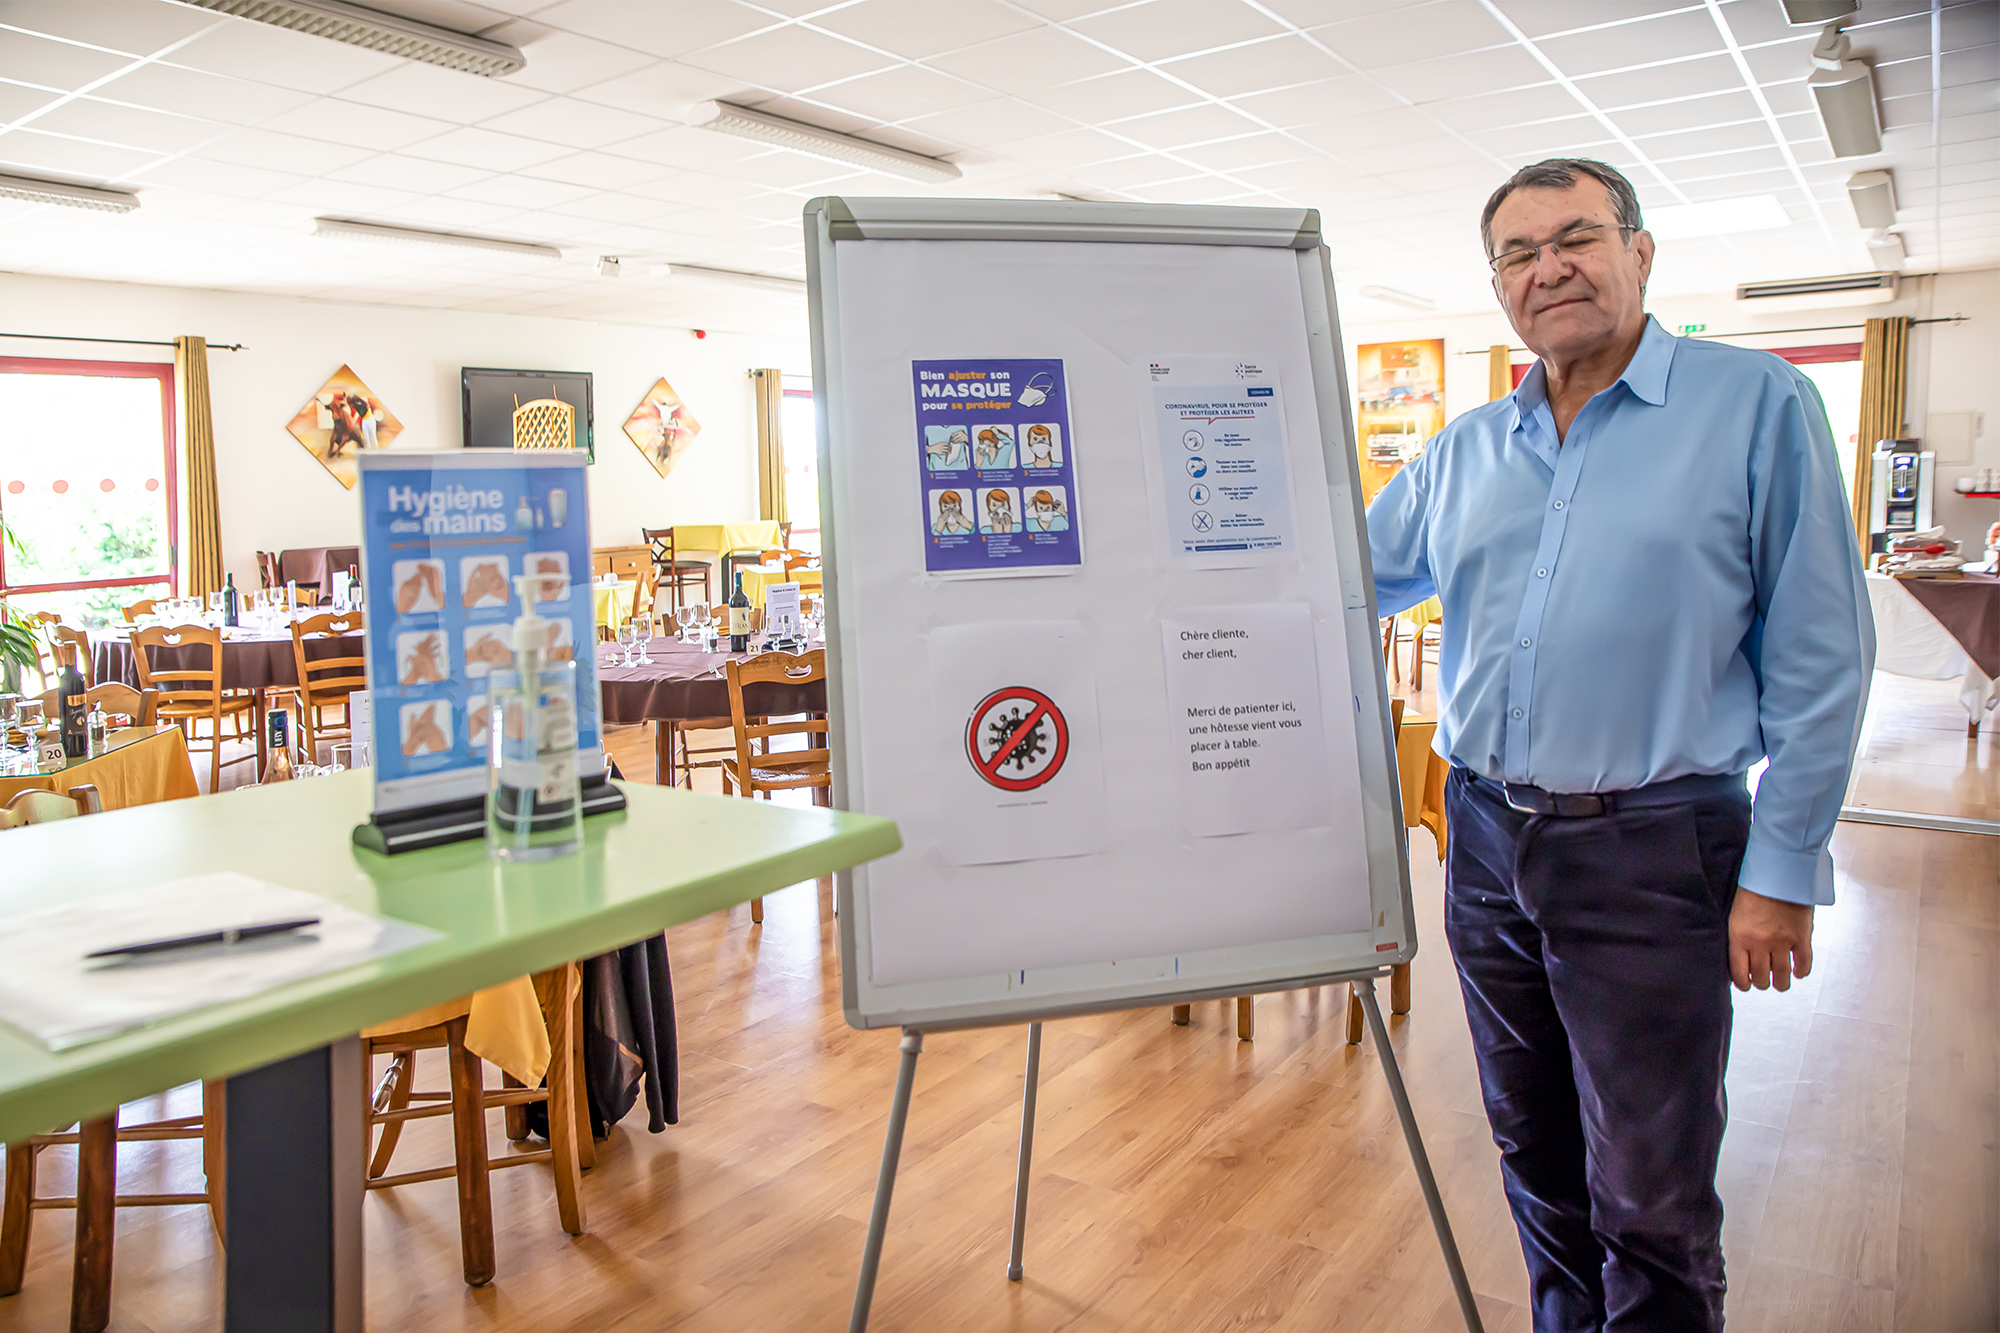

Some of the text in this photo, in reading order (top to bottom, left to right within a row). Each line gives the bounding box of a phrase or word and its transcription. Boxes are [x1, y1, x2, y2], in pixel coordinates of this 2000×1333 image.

[920, 371, 1010, 381] Bien ajuster son
[921, 383, 1011, 399] MASQUE
[922, 400, 1011, 412] pour se protéger
[388, 484, 504, 518] Hygiène
[390, 510, 507, 535] des mains
[1180, 629, 1249, 641] Chère cliente,
[1182, 649, 1237, 660] cher client,
[1187, 701, 1296, 717] Merci de patienter ici,
[1189, 719, 1302, 734] une hôtesse vient vous
[1190, 738, 1261, 753] placer à table.
[46, 749, 62, 759] 20
[1192, 758, 1250, 772] Bon appétit
